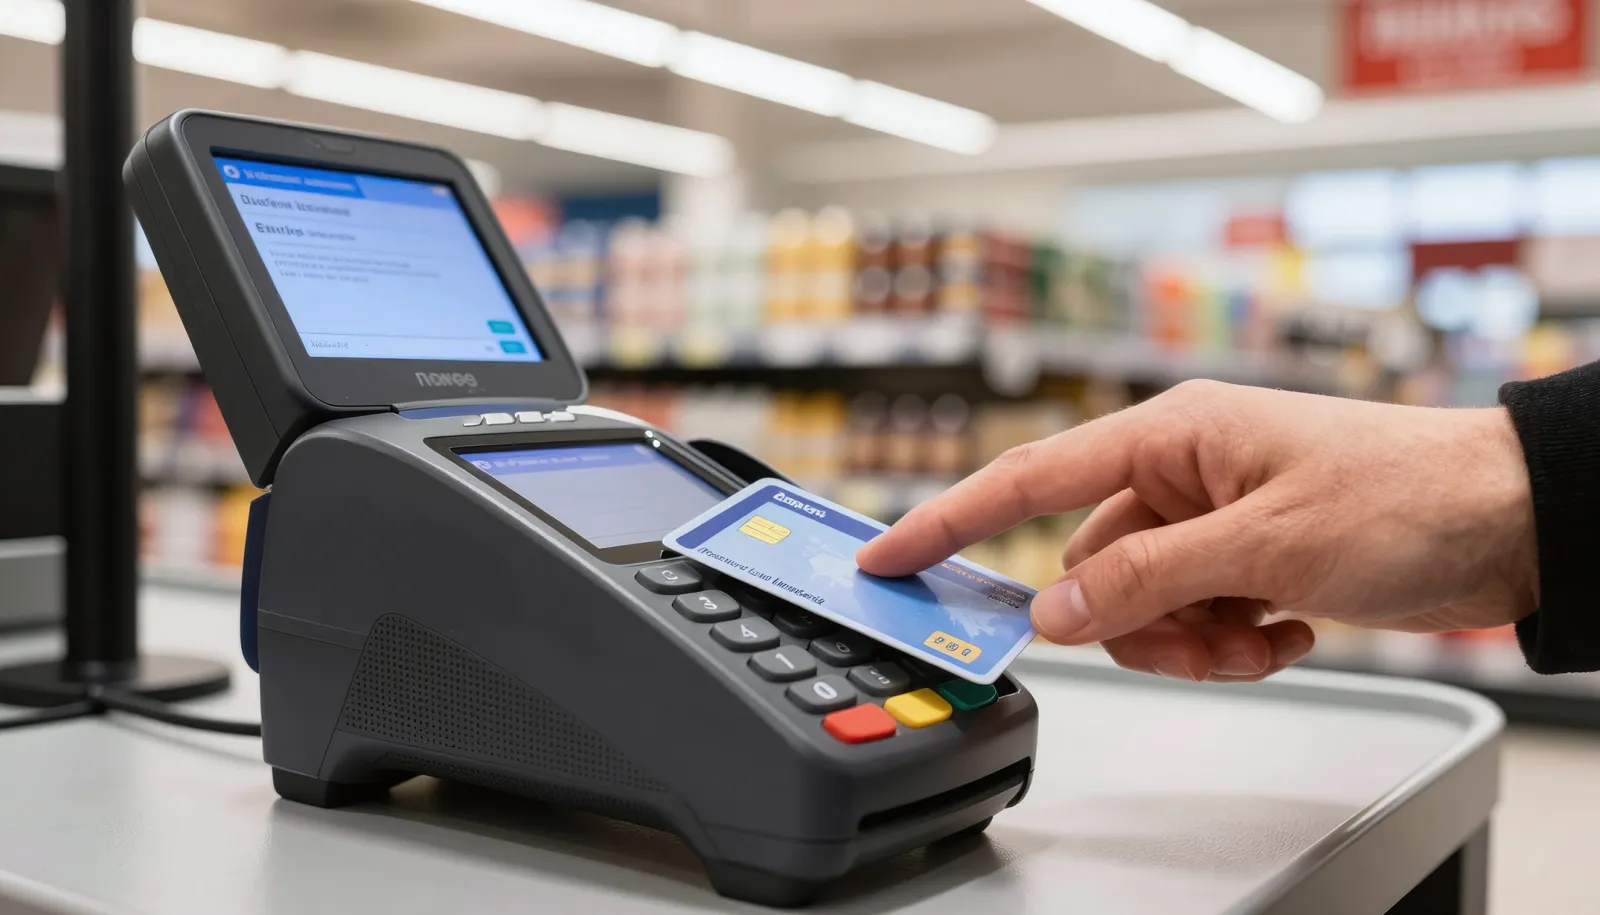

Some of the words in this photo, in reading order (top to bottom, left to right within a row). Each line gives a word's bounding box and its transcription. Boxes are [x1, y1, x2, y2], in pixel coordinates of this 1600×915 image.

[740, 623, 758, 639] 4
[775, 651, 796, 670] 1
[813, 681, 838, 700] 0
